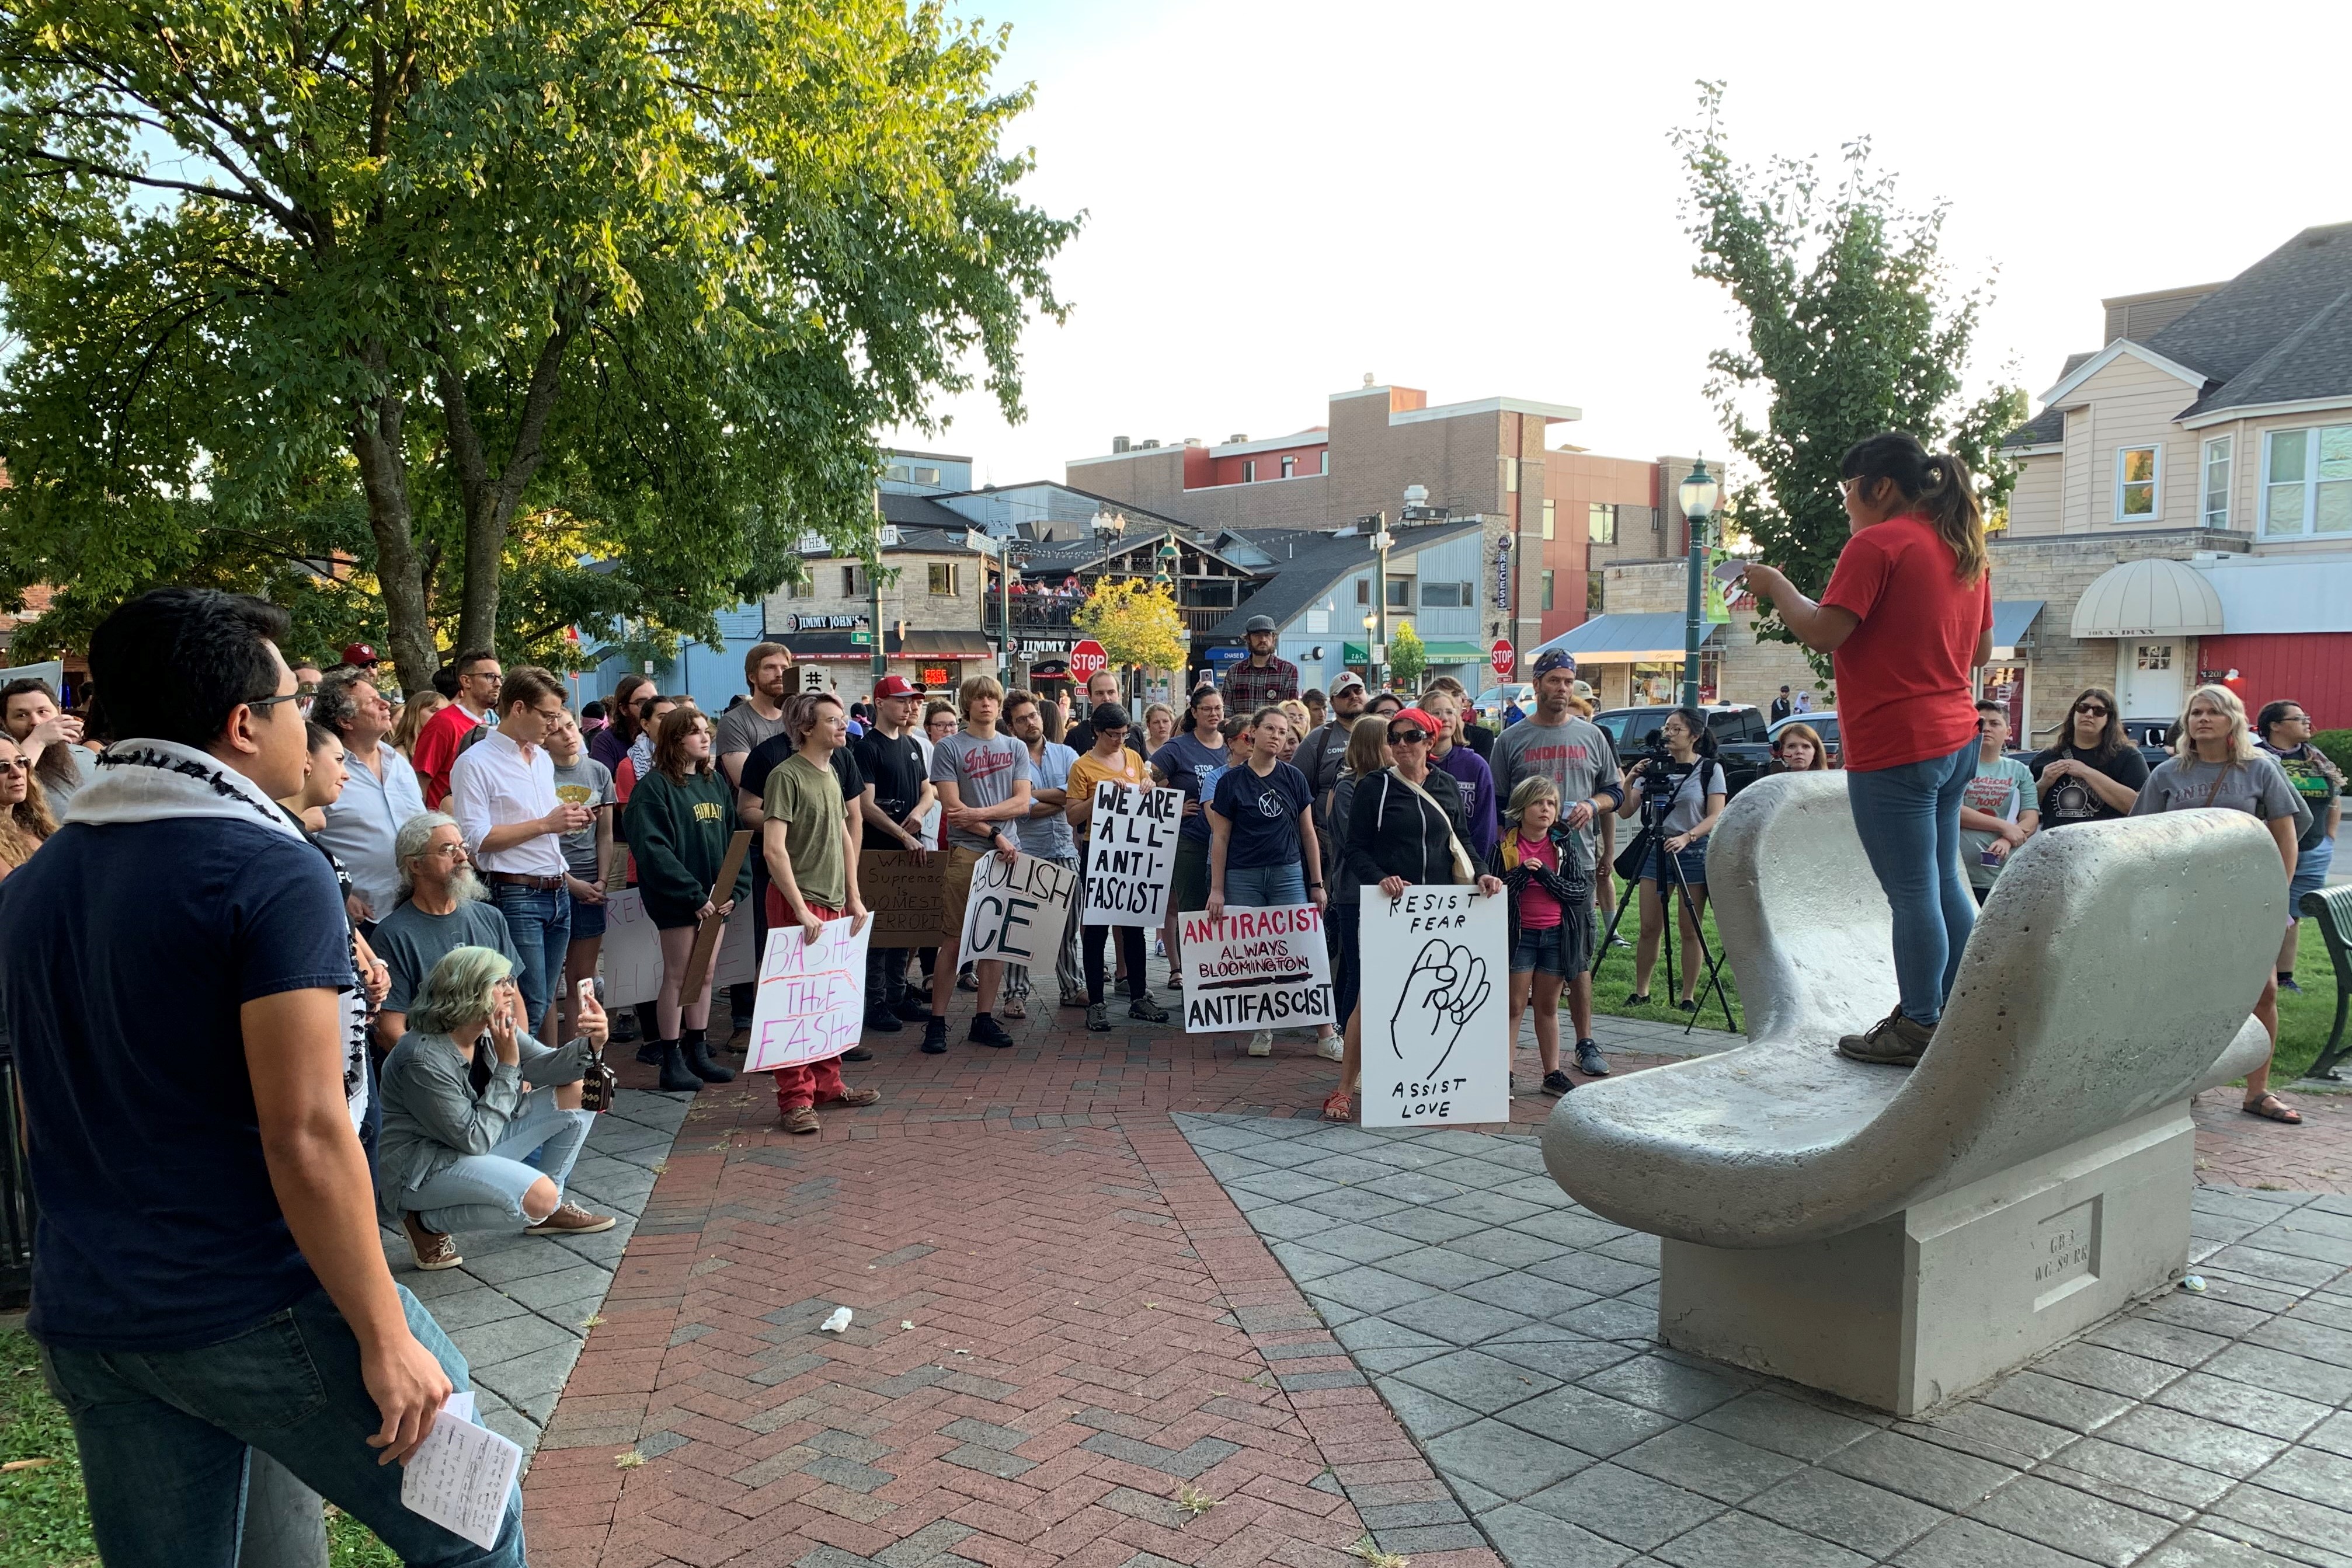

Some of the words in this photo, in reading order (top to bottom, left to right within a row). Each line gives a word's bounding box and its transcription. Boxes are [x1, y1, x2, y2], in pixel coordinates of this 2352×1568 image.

[803, 536, 822, 549] THE
[881, 529, 895, 542] UB
[1499, 553, 1507, 608] RECESS
[799, 616, 826, 630] JIMMY
[829, 615, 860, 630] JOHN'S
[1023, 640, 1066, 652] JIMMY
[1072, 653, 1105, 671] STOP
[1492, 650, 1513, 664] STOP
[925, 669, 947, 677] FREE
[962, 745, 1013, 773] Indiana
[1524, 745, 1587, 762] INDIANA
[1098, 784, 1132, 816] WE
[1136, 790, 1178, 824] ARE
[878, 853, 935, 868] Whe
[1095, 850, 1164, 878] ANTI-
[868, 868, 944, 887] Supremac
[969, 851, 1077, 912] ABOLISH
[897, 886, 907, 896] is
[1085, 877, 1164, 915] FASCIST
[865, 895, 944, 910] DOMEST
[1389, 893, 1481, 918] RESIST
[966, 895, 1040, 958] ICE
[1183, 908, 1320, 946] ANTIRACIST
[1410, 914, 1466, 934] FEAR
[766, 924, 851, 976] BASH
[1220, 939, 1288, 960] ALWAYS
[1199, 955, 1310, 978] BLOOMINGTON
[787, 976, 844, 1015] THE
[1188, 983, 1332, 1028] ANTIFASCIST
[755, 1012, 853, 1071] FASH
[1391, 1078, 1467, 1098] ASSIST
[1402, 1101, 1450, 1118] LOVE
